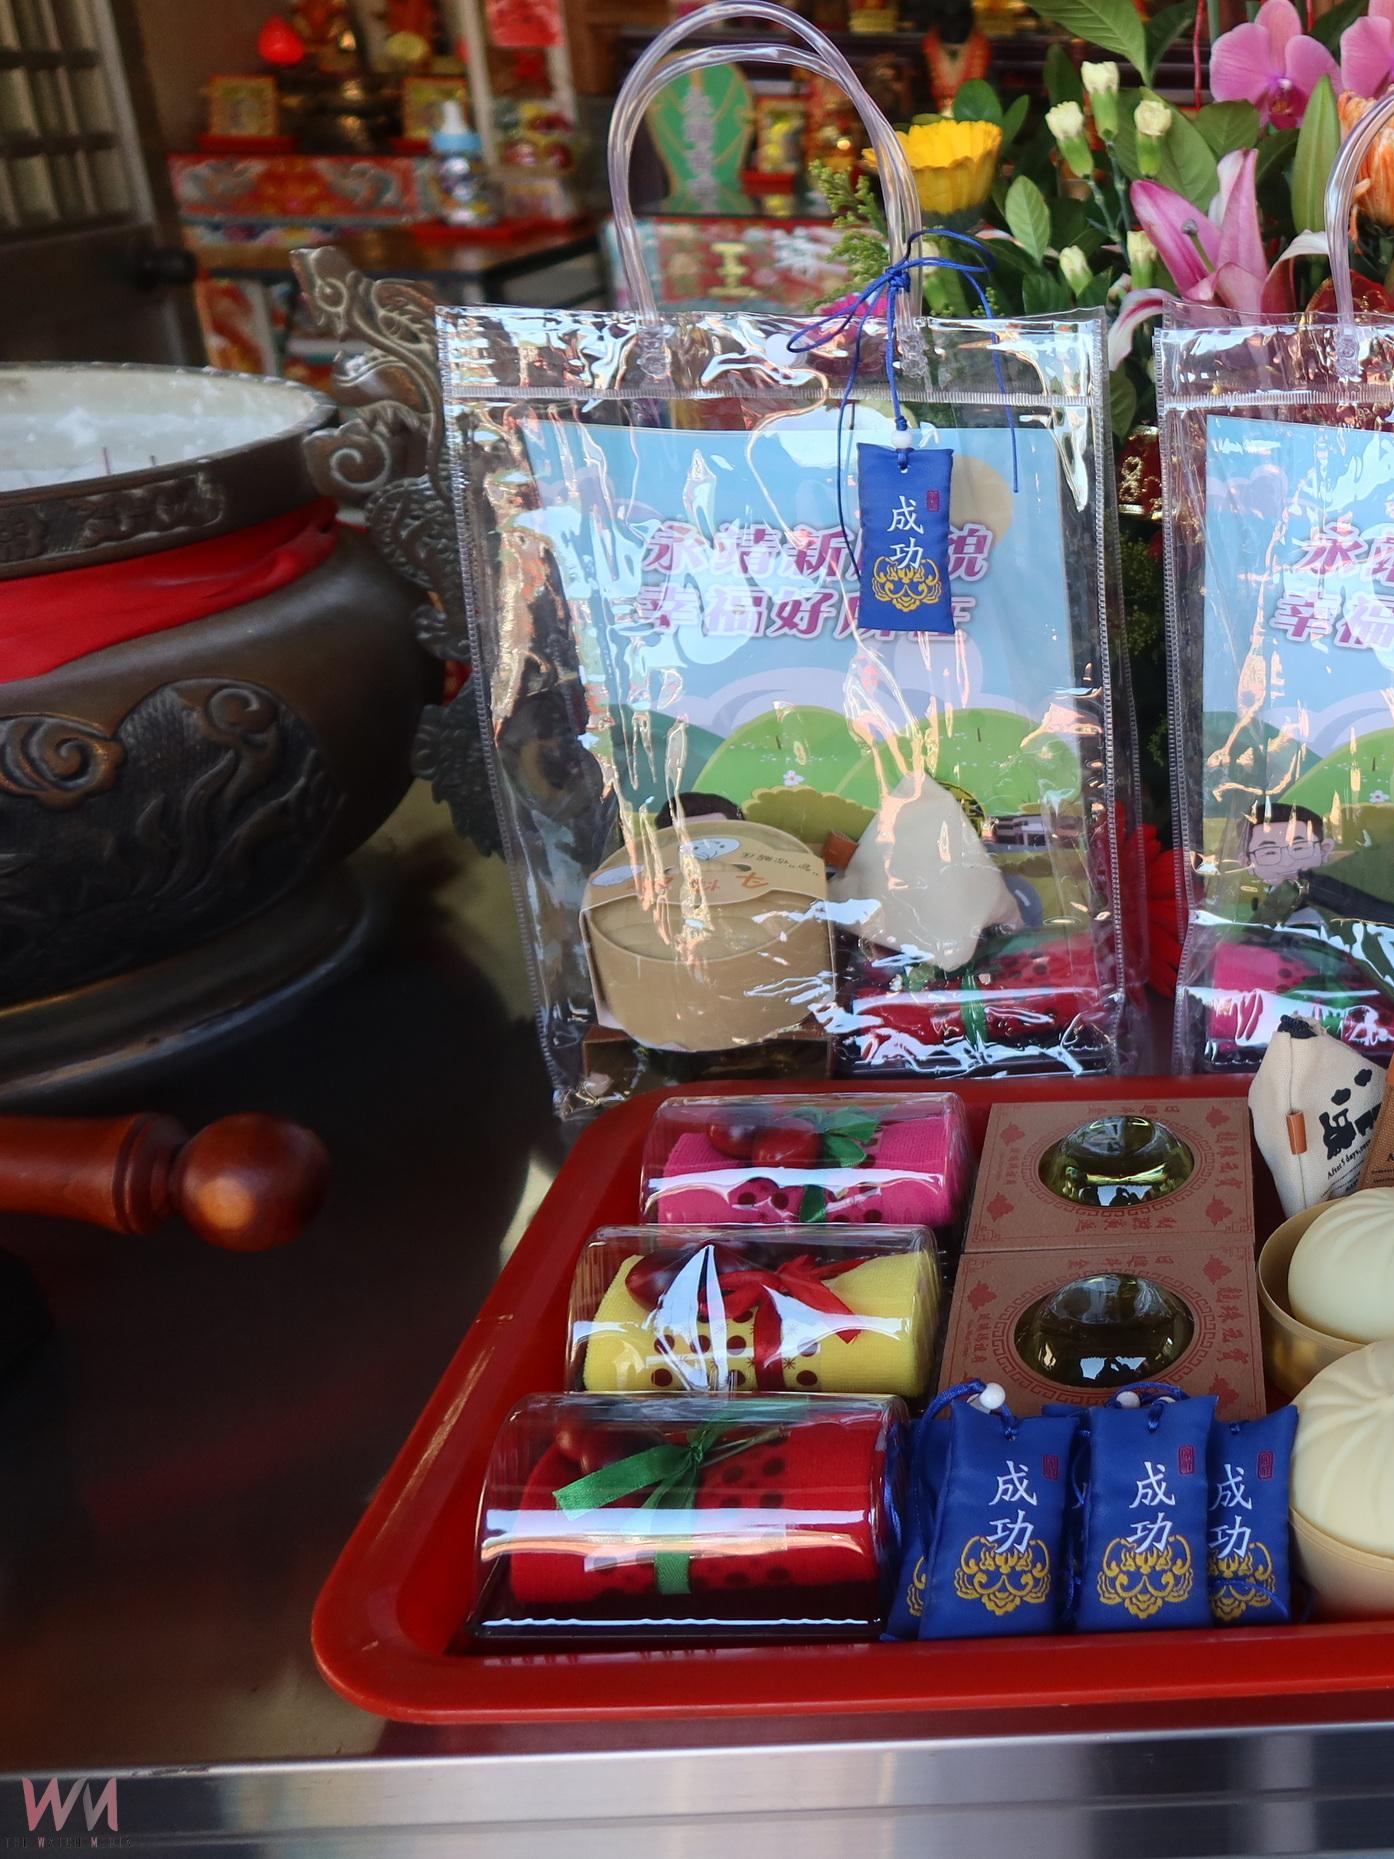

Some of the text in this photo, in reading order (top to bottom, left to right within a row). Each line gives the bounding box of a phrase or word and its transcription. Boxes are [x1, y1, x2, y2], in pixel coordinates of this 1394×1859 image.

[642, 522, 993, 581] 永靖新貌
[887, 495, 925, 570] 成功
[988, 1460, 1037, 1554] 成功
[1129, 1461, 1175, 1553] 成功
[1208, 1463, 1252, 1559] 成功
